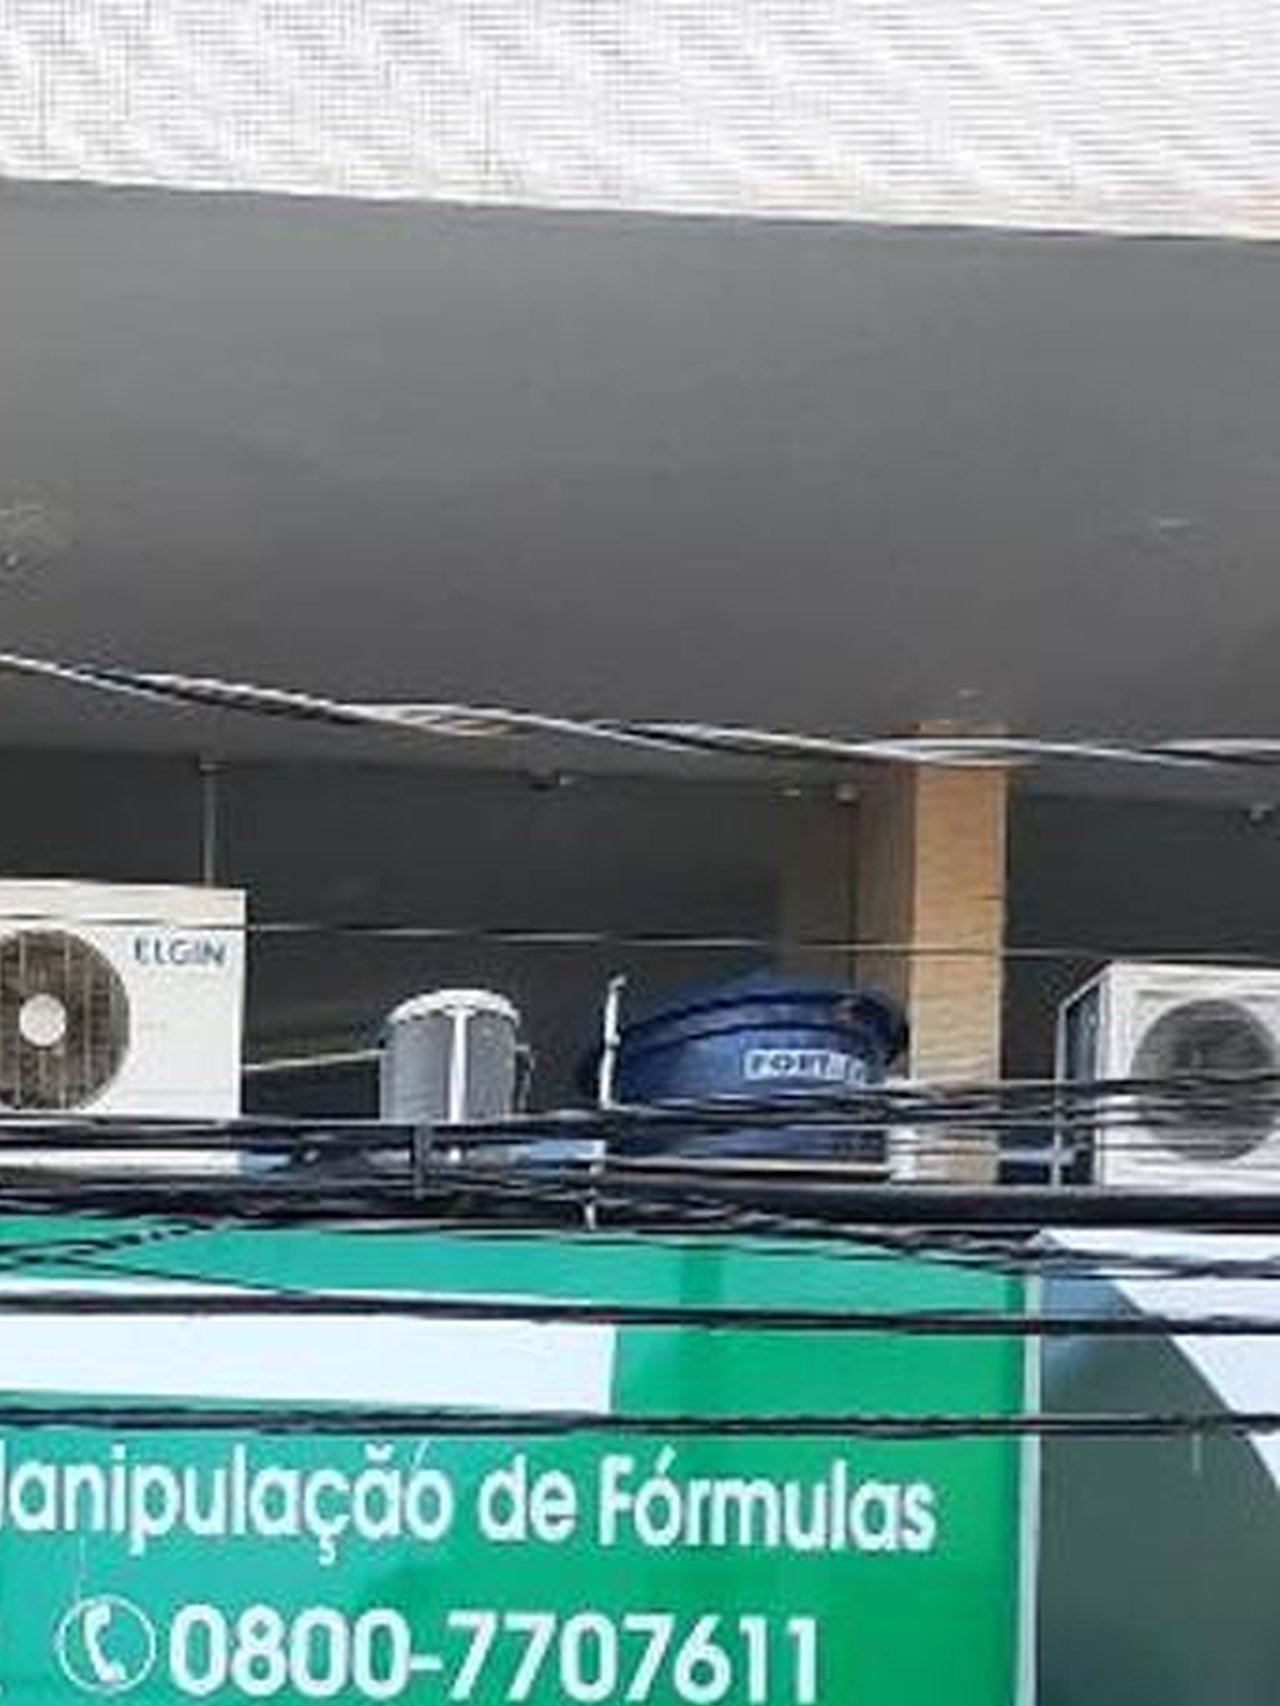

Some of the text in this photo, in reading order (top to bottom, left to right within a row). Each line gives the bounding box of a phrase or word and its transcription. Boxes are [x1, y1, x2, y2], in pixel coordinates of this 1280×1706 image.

[133, 936, 228, 968] ELGIN
[480, 1456, 575, 1539] de
[602, 1457, 934, 1549] Fórmulas
[171, 1605, 814, 1701] 0800-7707611
